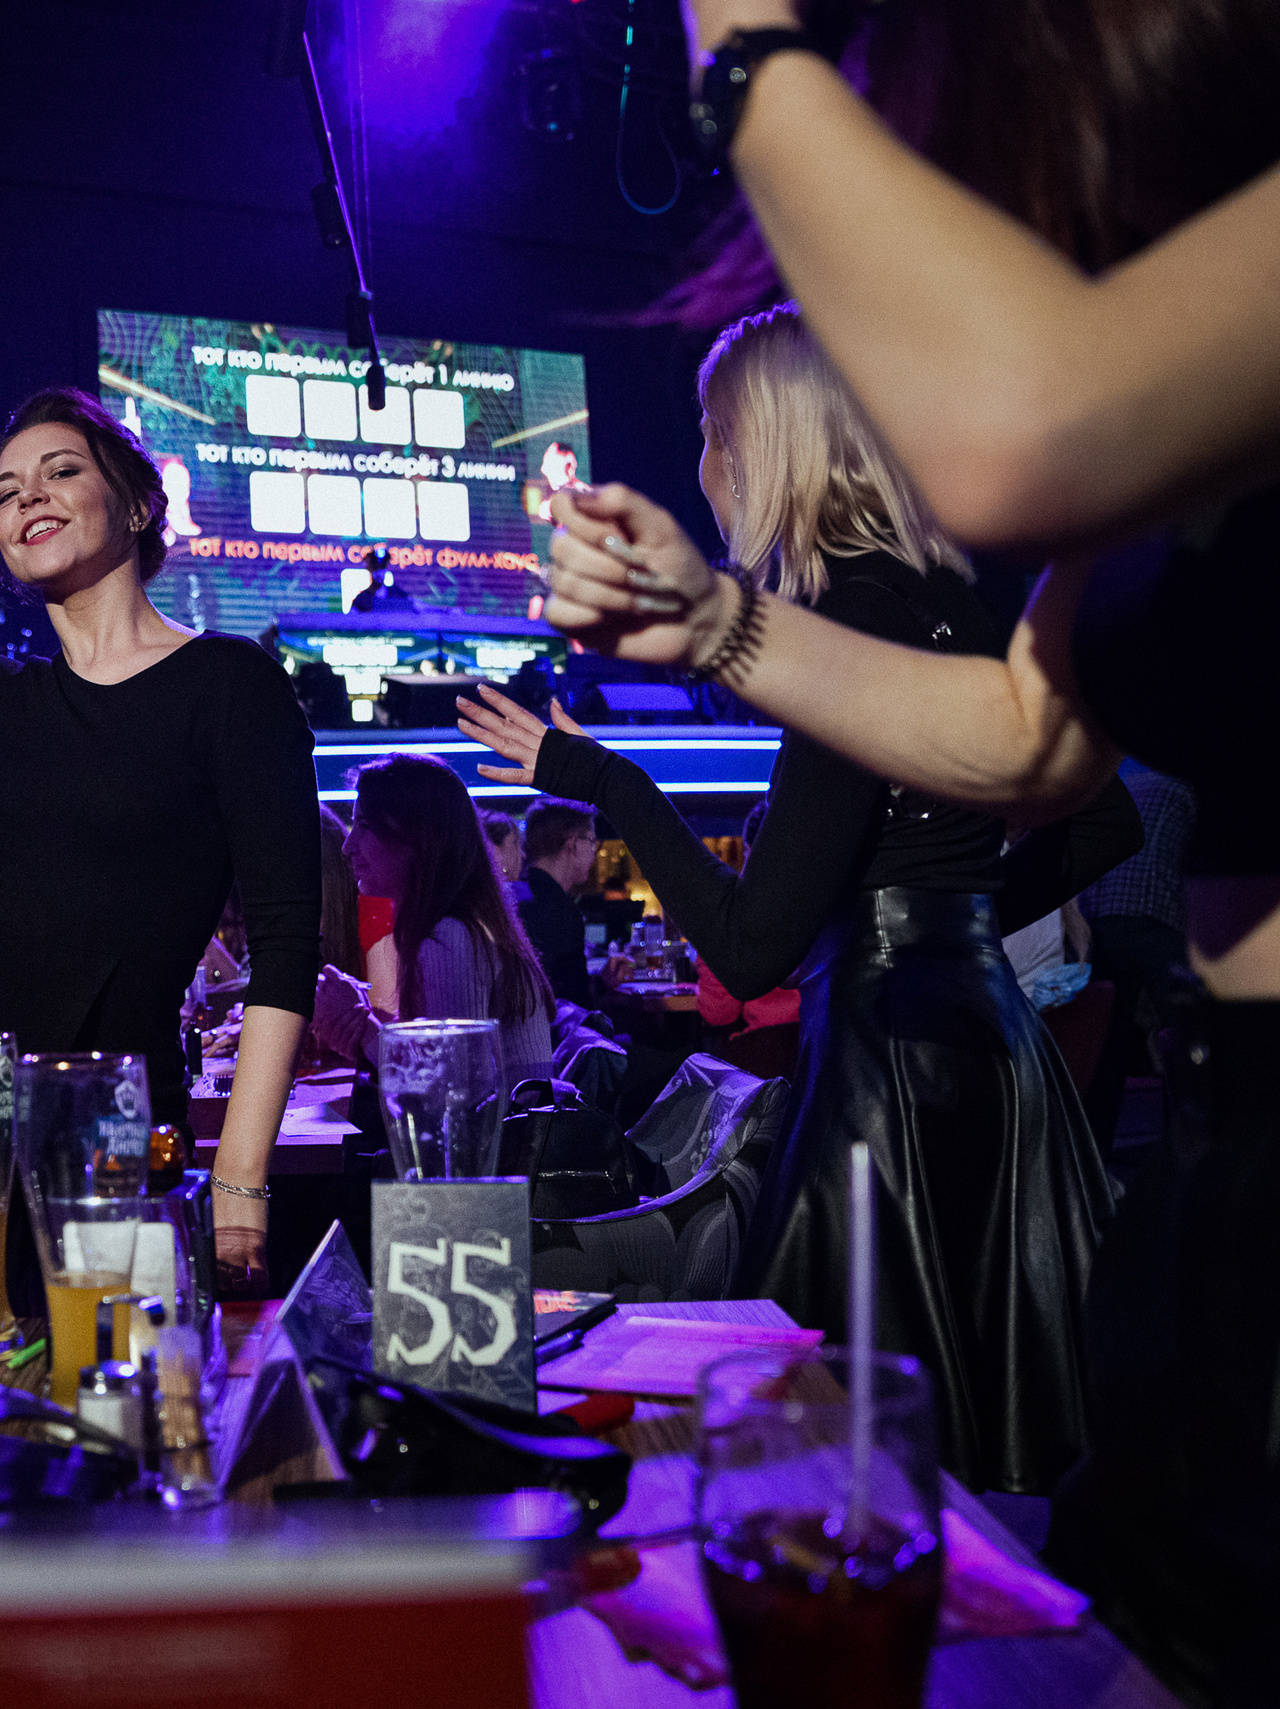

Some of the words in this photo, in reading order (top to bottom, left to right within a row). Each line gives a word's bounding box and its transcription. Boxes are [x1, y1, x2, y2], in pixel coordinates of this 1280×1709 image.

[438, 363, 448, 385] 1
[441, 455, 456, 478] 3
[347, 543, 434, 570] серёт
[386, 1237, 518, 1367] 55
